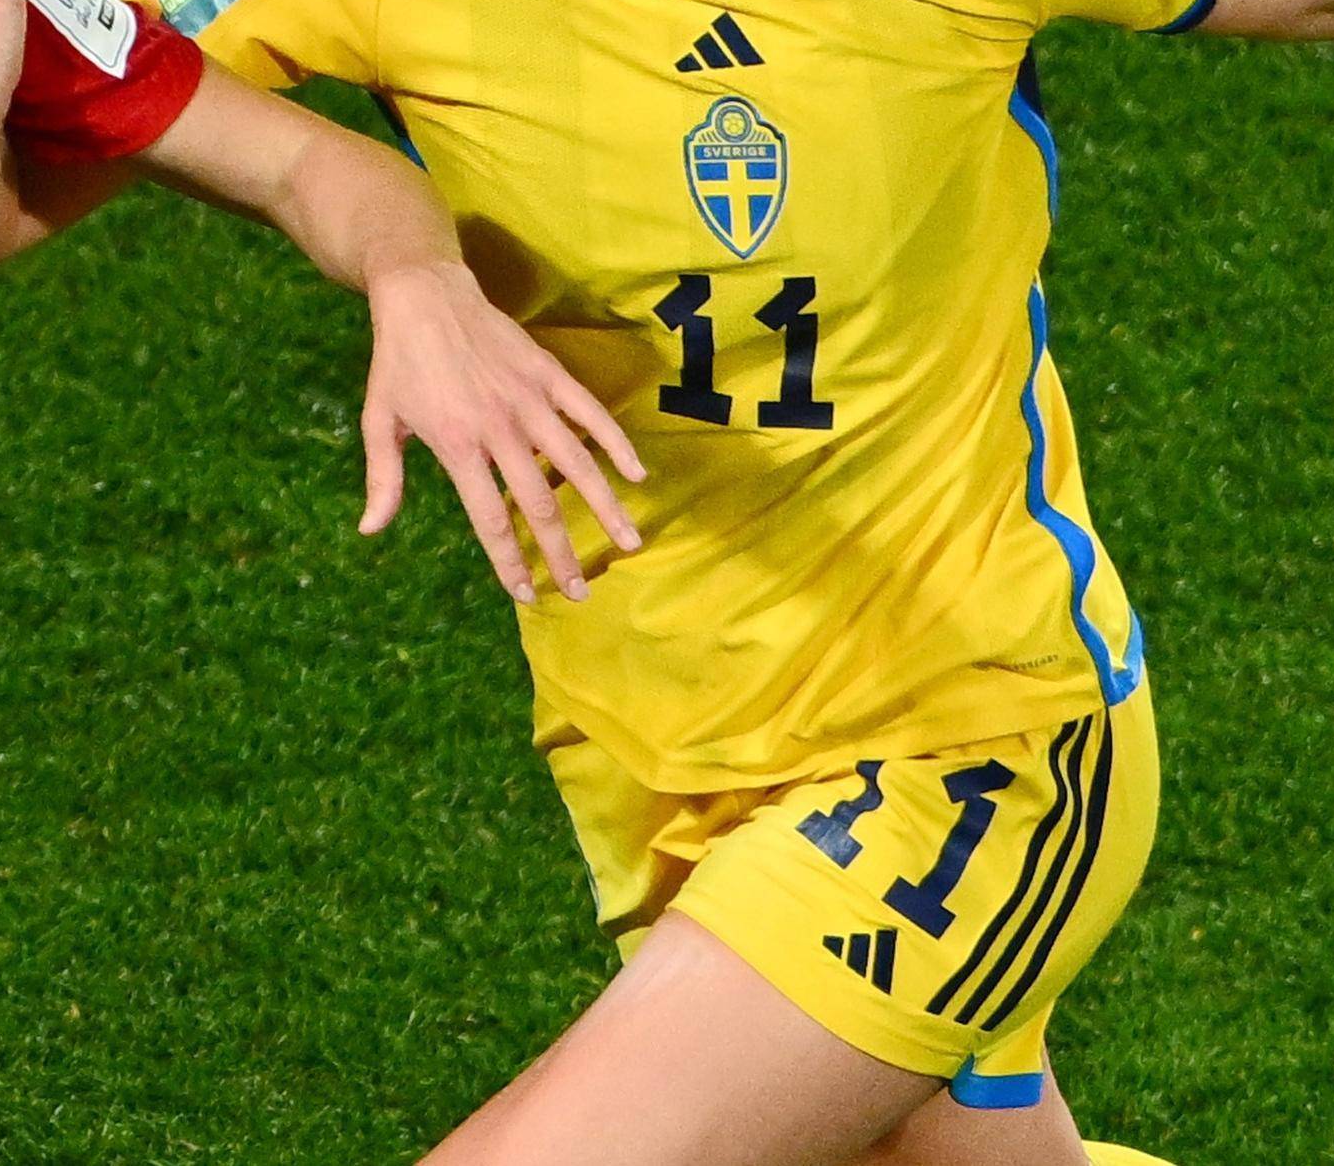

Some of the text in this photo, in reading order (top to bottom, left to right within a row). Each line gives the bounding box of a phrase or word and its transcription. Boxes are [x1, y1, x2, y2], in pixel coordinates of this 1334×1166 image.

[703, 146, 767, 157] SVERIGE
[652, 273, 835, 431] 11
[794, 757, 1017, 941] 11
